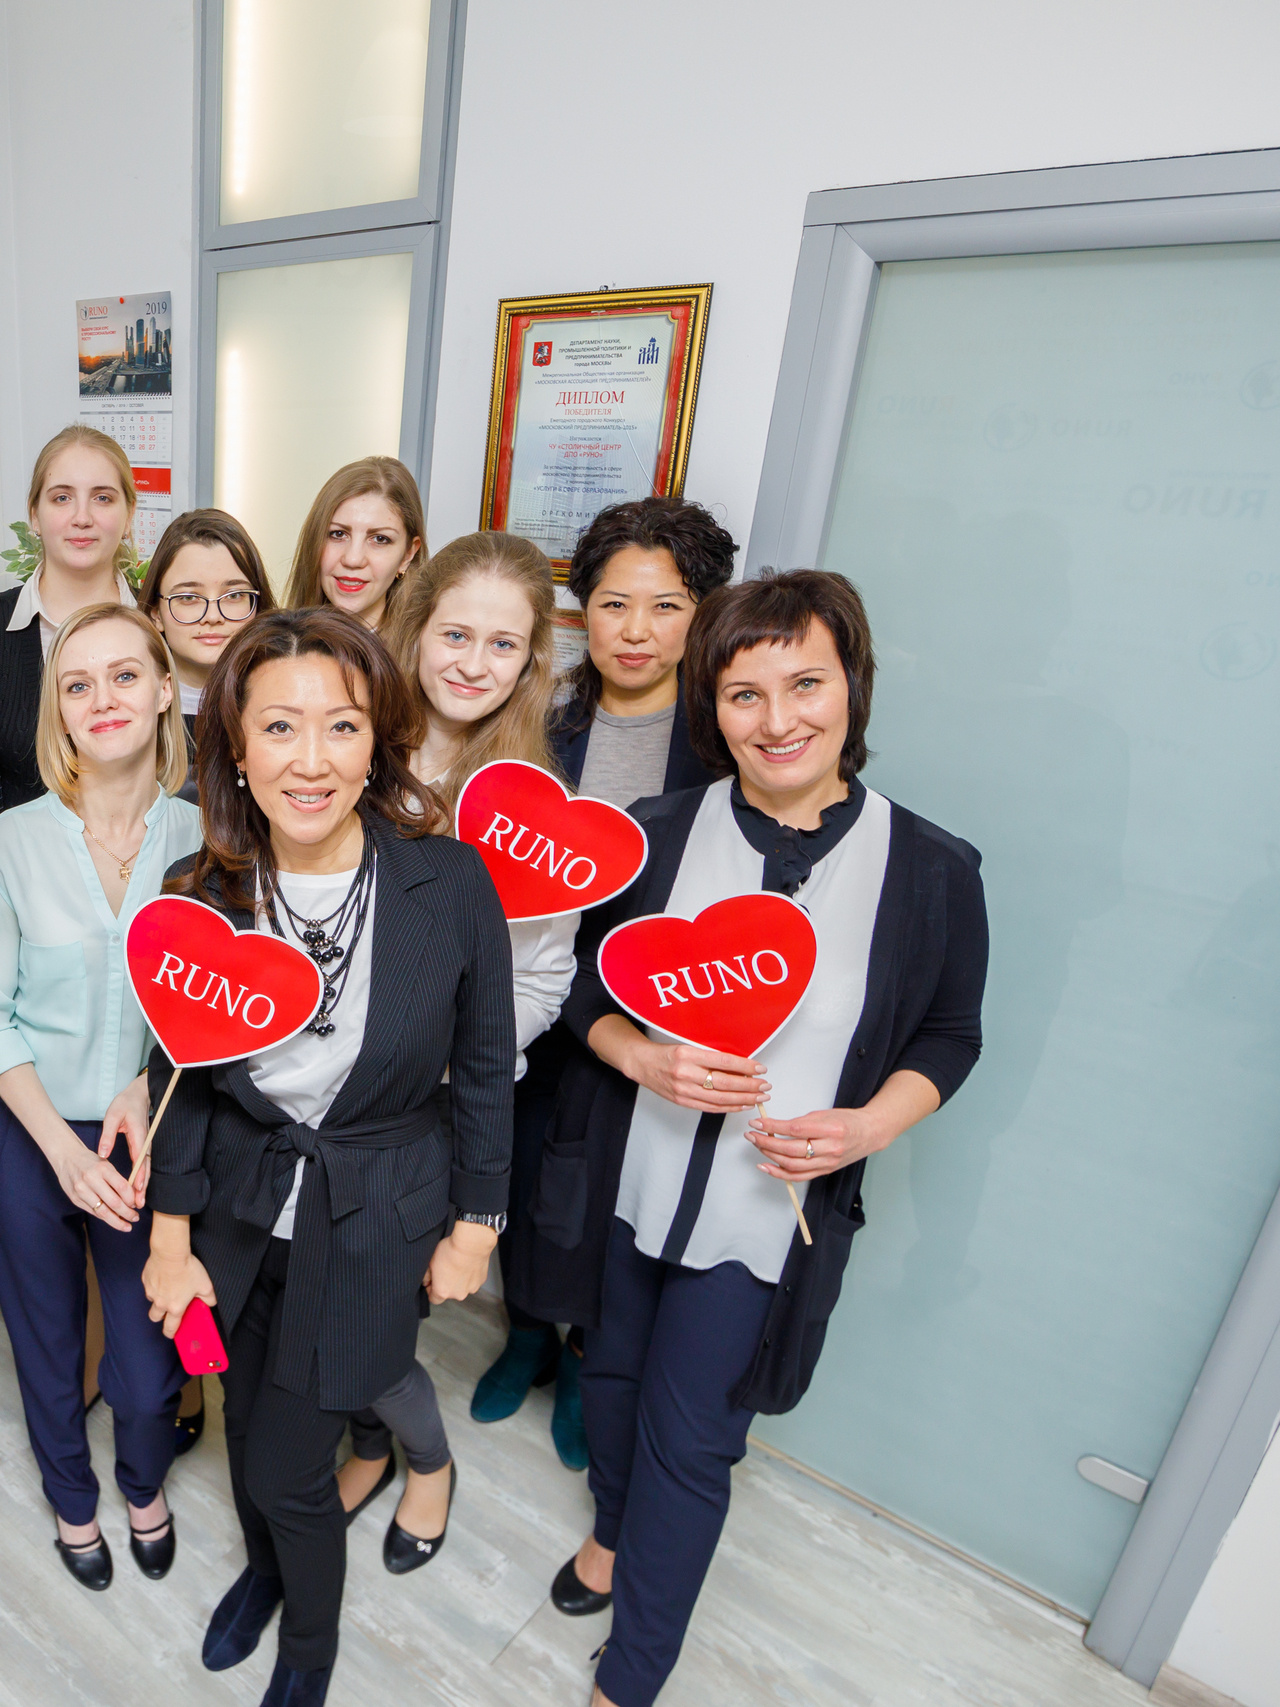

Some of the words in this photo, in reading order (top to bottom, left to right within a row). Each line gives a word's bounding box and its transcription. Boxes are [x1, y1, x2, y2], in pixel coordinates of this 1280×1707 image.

[89, 305, 108, 317] RUNO
[145, 301, 168, 316] 2019
[555, 390, 626, 407] ДИПЛОМ
[564, 408, 612, 416] ПОБЕДИТЕЛЯ
[601, 443, 622, 451] ЦЕНТР
[541, 509, 598, 519] ОРГКОМИТ
[478, 811, 597, 890] RUNO
[647, 949, 789, 1008] RUNO
[151, 951, 275, 1029] RUNO
